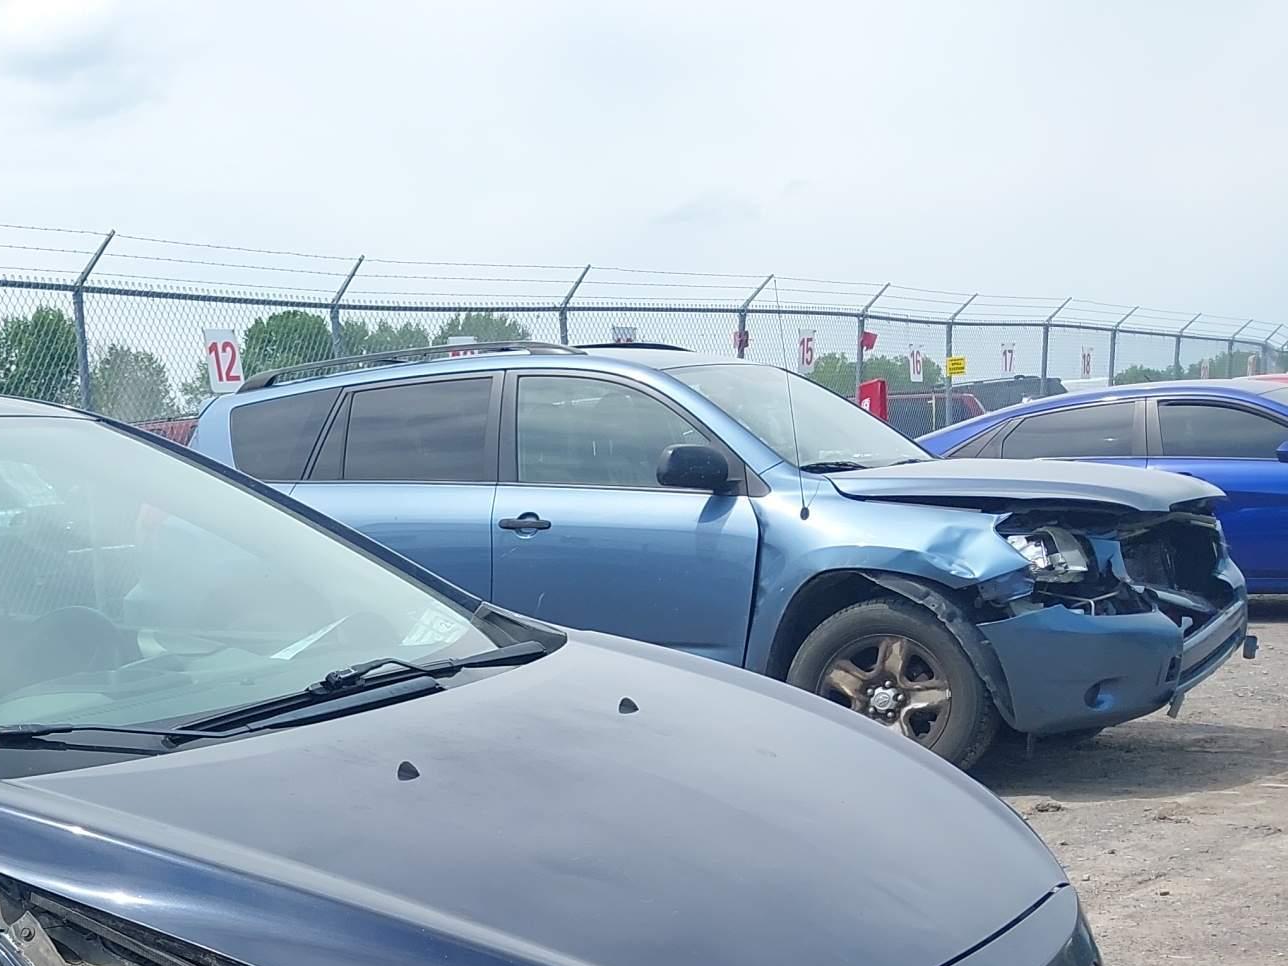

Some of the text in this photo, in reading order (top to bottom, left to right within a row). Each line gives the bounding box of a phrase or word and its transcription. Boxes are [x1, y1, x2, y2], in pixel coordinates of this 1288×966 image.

[209, 341, 240, 382] 12
[799, 337, 813, 366] 15
[910, 350, 921, 375] 16
[1003, 349, 1013, 372] 17
[1082, 353, 1091, 375] 18
